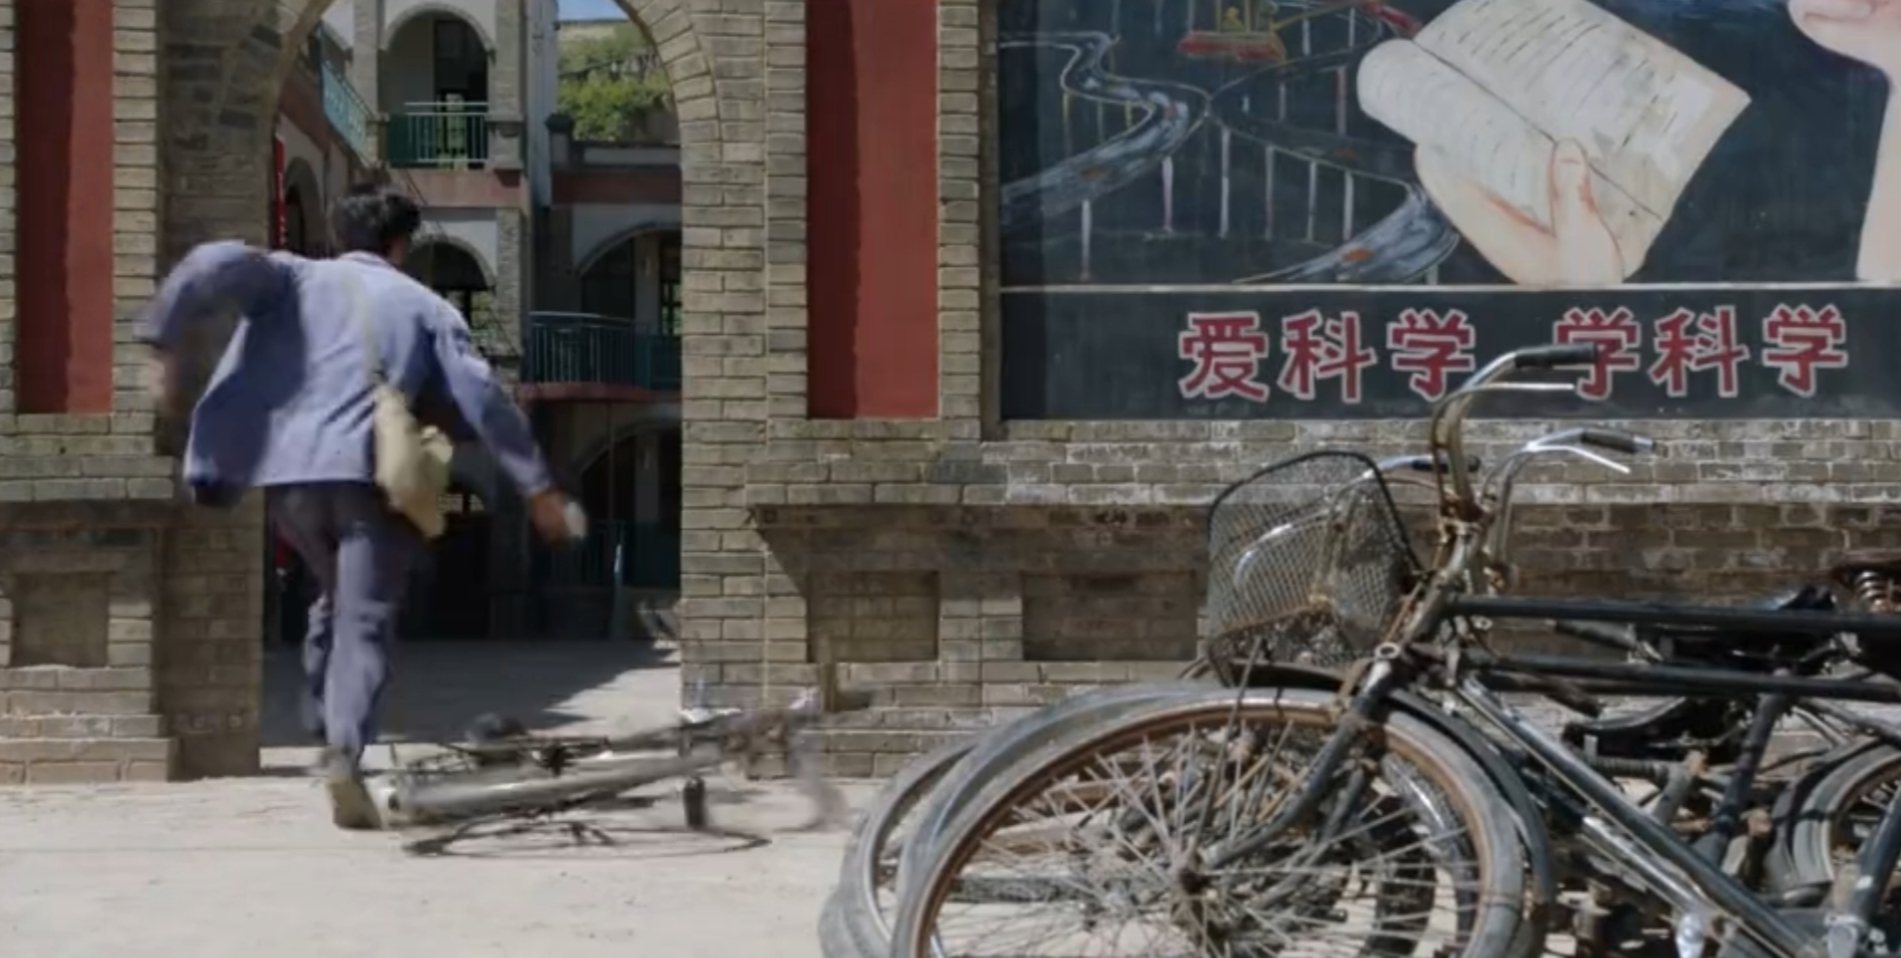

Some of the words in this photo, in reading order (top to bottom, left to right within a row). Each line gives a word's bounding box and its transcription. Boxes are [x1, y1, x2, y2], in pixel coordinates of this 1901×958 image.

[1178, 308, 1475, 403] 爱科学
[1553, 303, 1848, 399] 学科学
